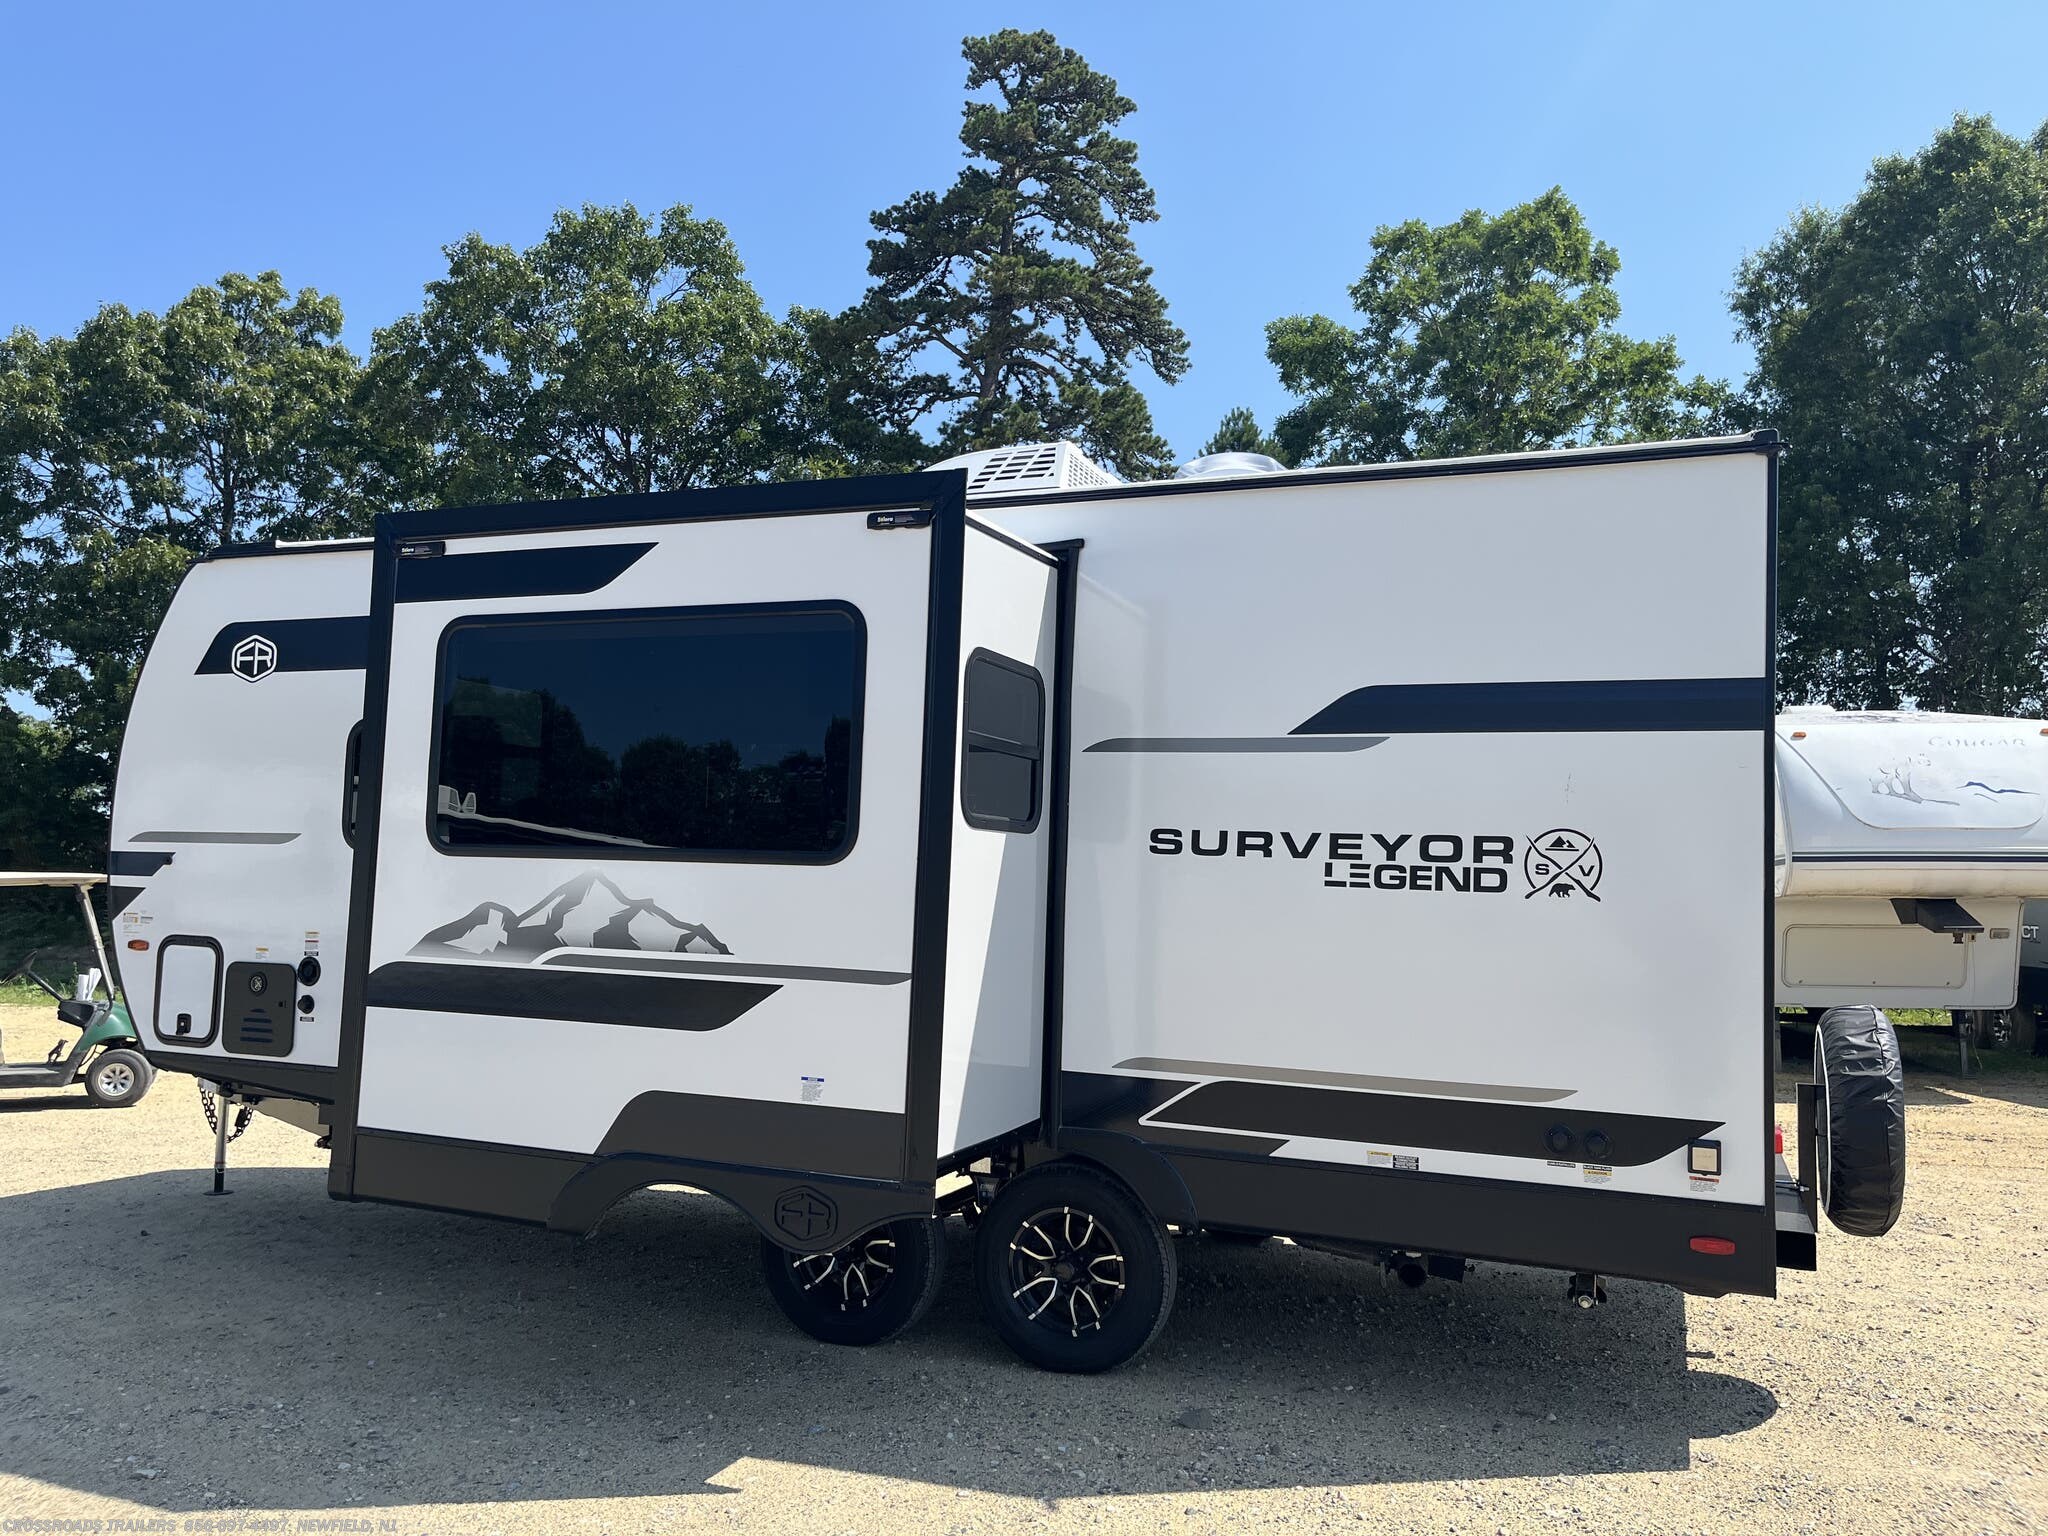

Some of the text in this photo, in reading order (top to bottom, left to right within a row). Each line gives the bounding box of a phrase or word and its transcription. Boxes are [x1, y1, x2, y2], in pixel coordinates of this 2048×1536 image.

[1149, 828, 1514, 864] SURVEYOR
[1324, 862, 1508, 893] LEGEND
[1535, 863, 1595, 877] S V
